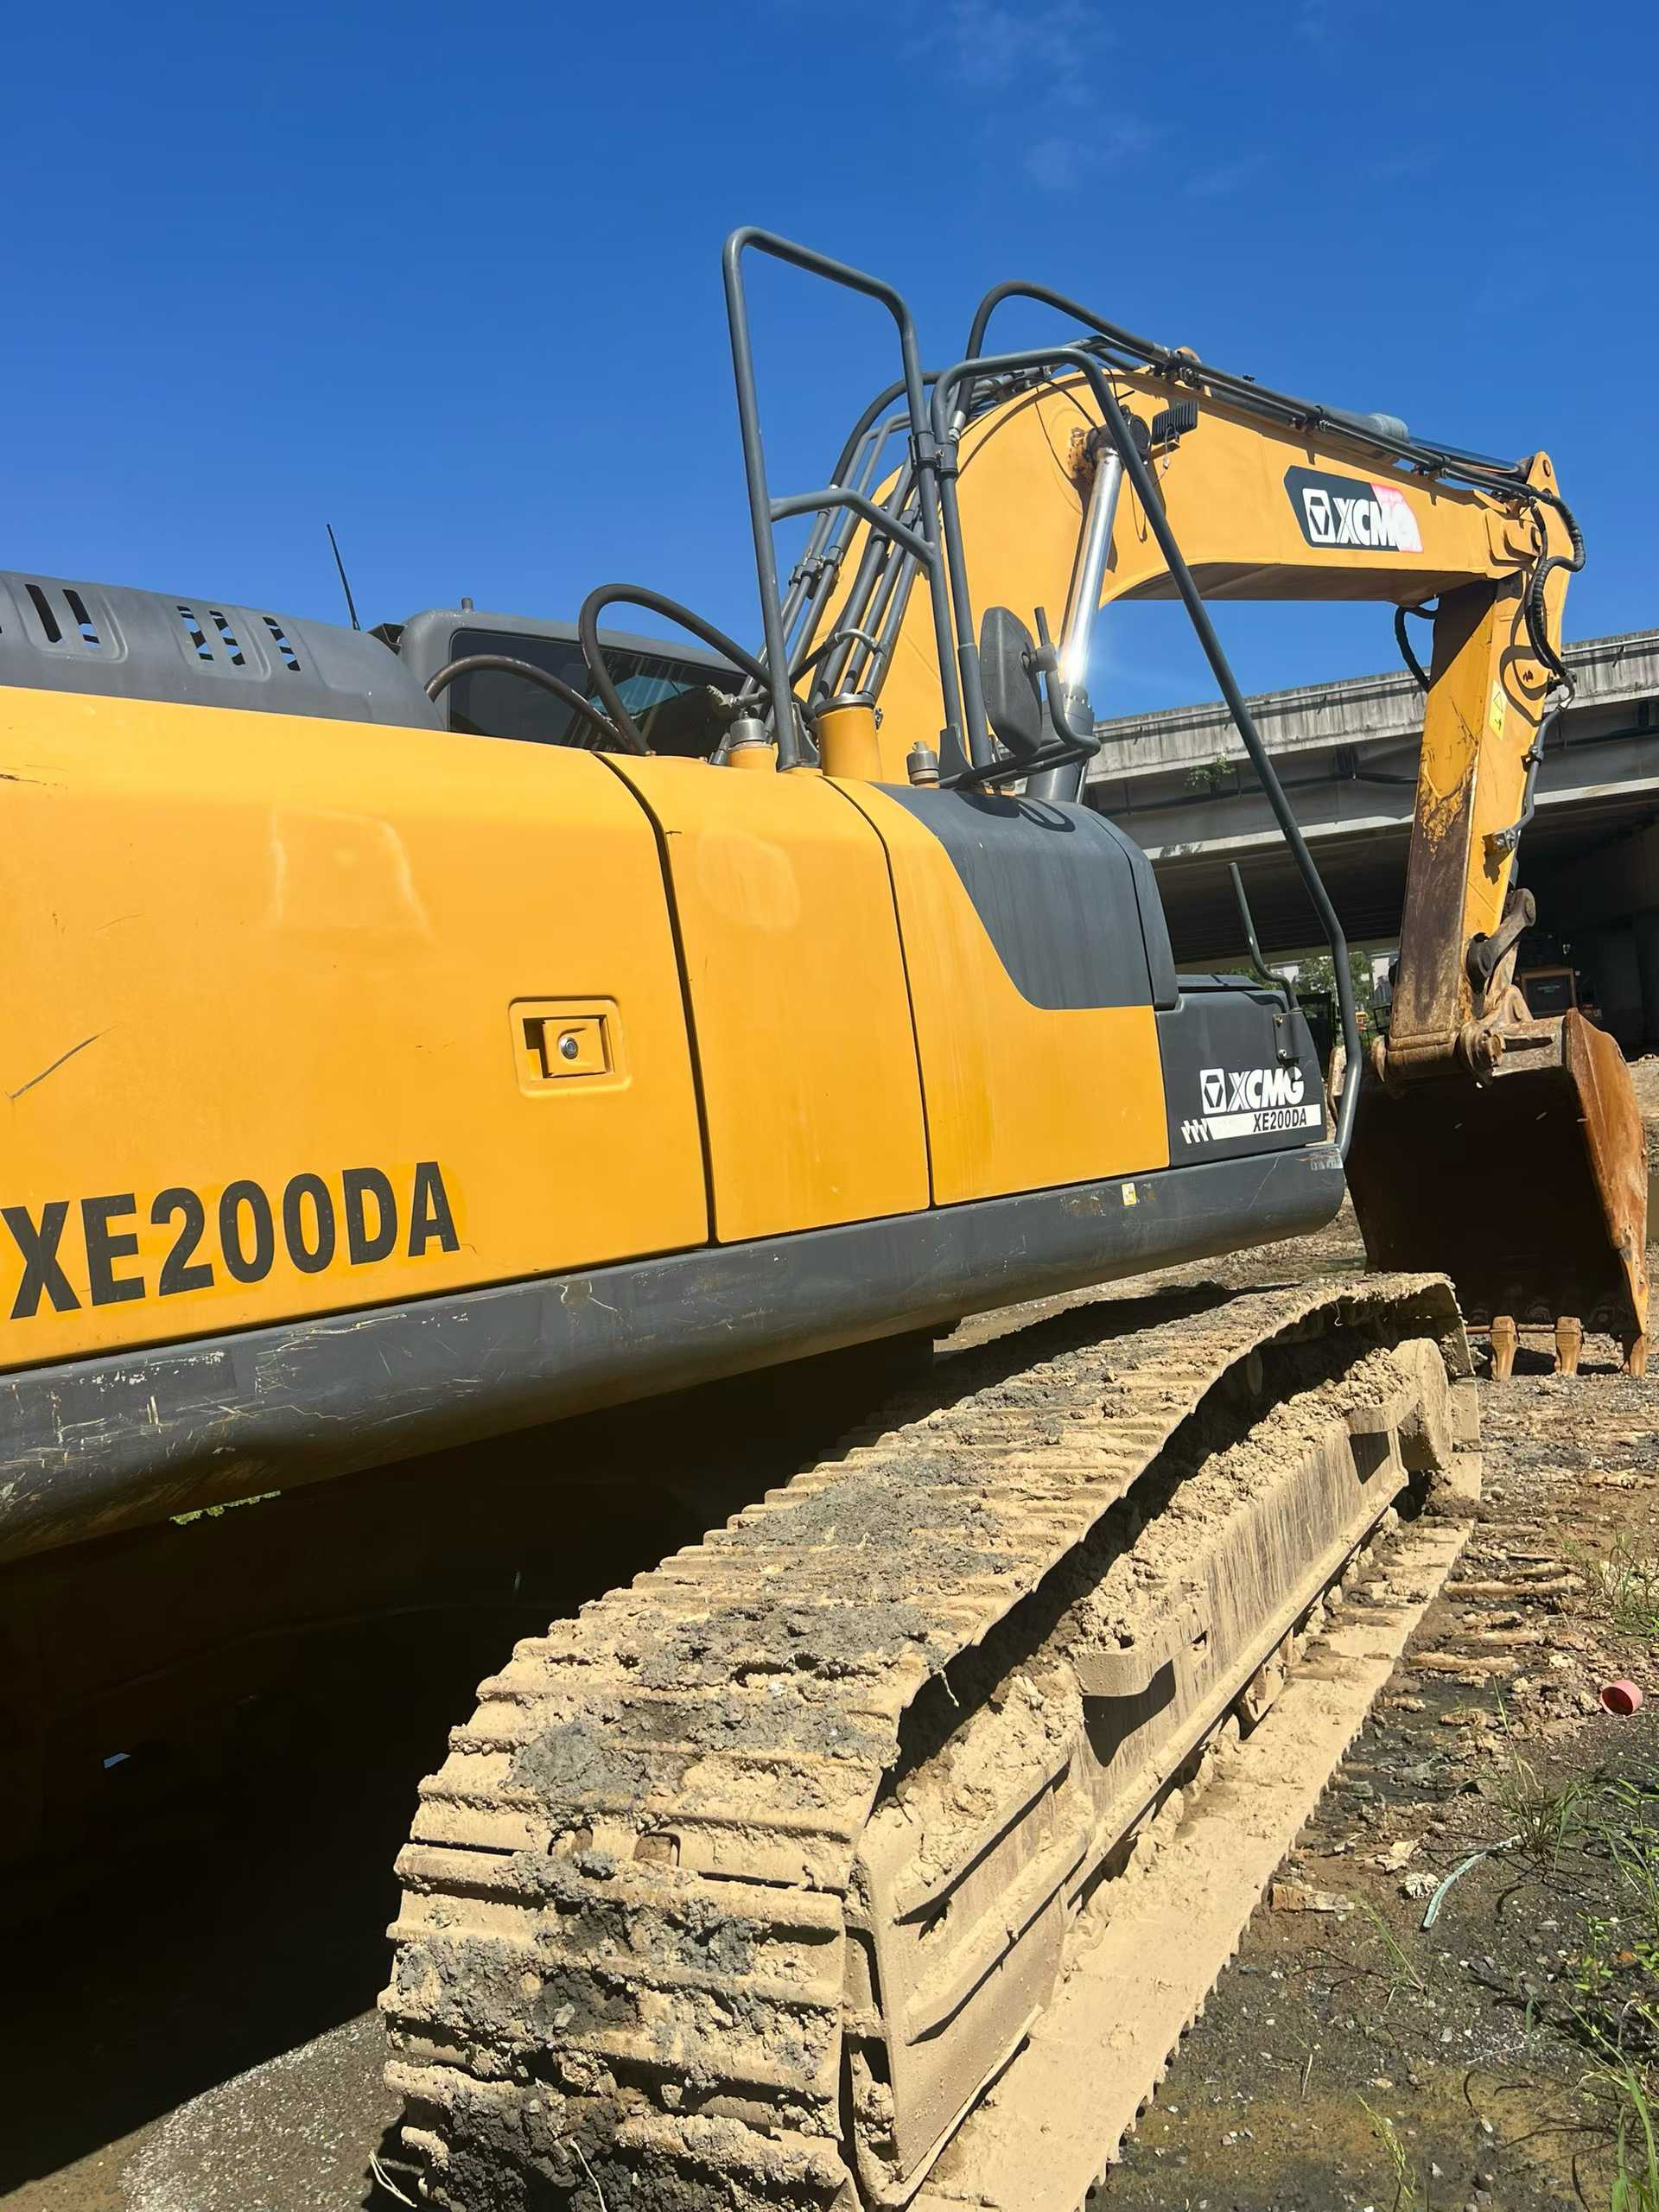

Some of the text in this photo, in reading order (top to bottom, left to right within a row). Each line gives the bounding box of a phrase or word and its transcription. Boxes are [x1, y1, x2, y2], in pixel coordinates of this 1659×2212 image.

[1333, 498, 1419, 548] XCM
[1227, 1067, 1305, 1111] XCMG
[1253, 1108, 1306, 1133] XE200DA
[2, 1161, 460, 1319] XE200DA
